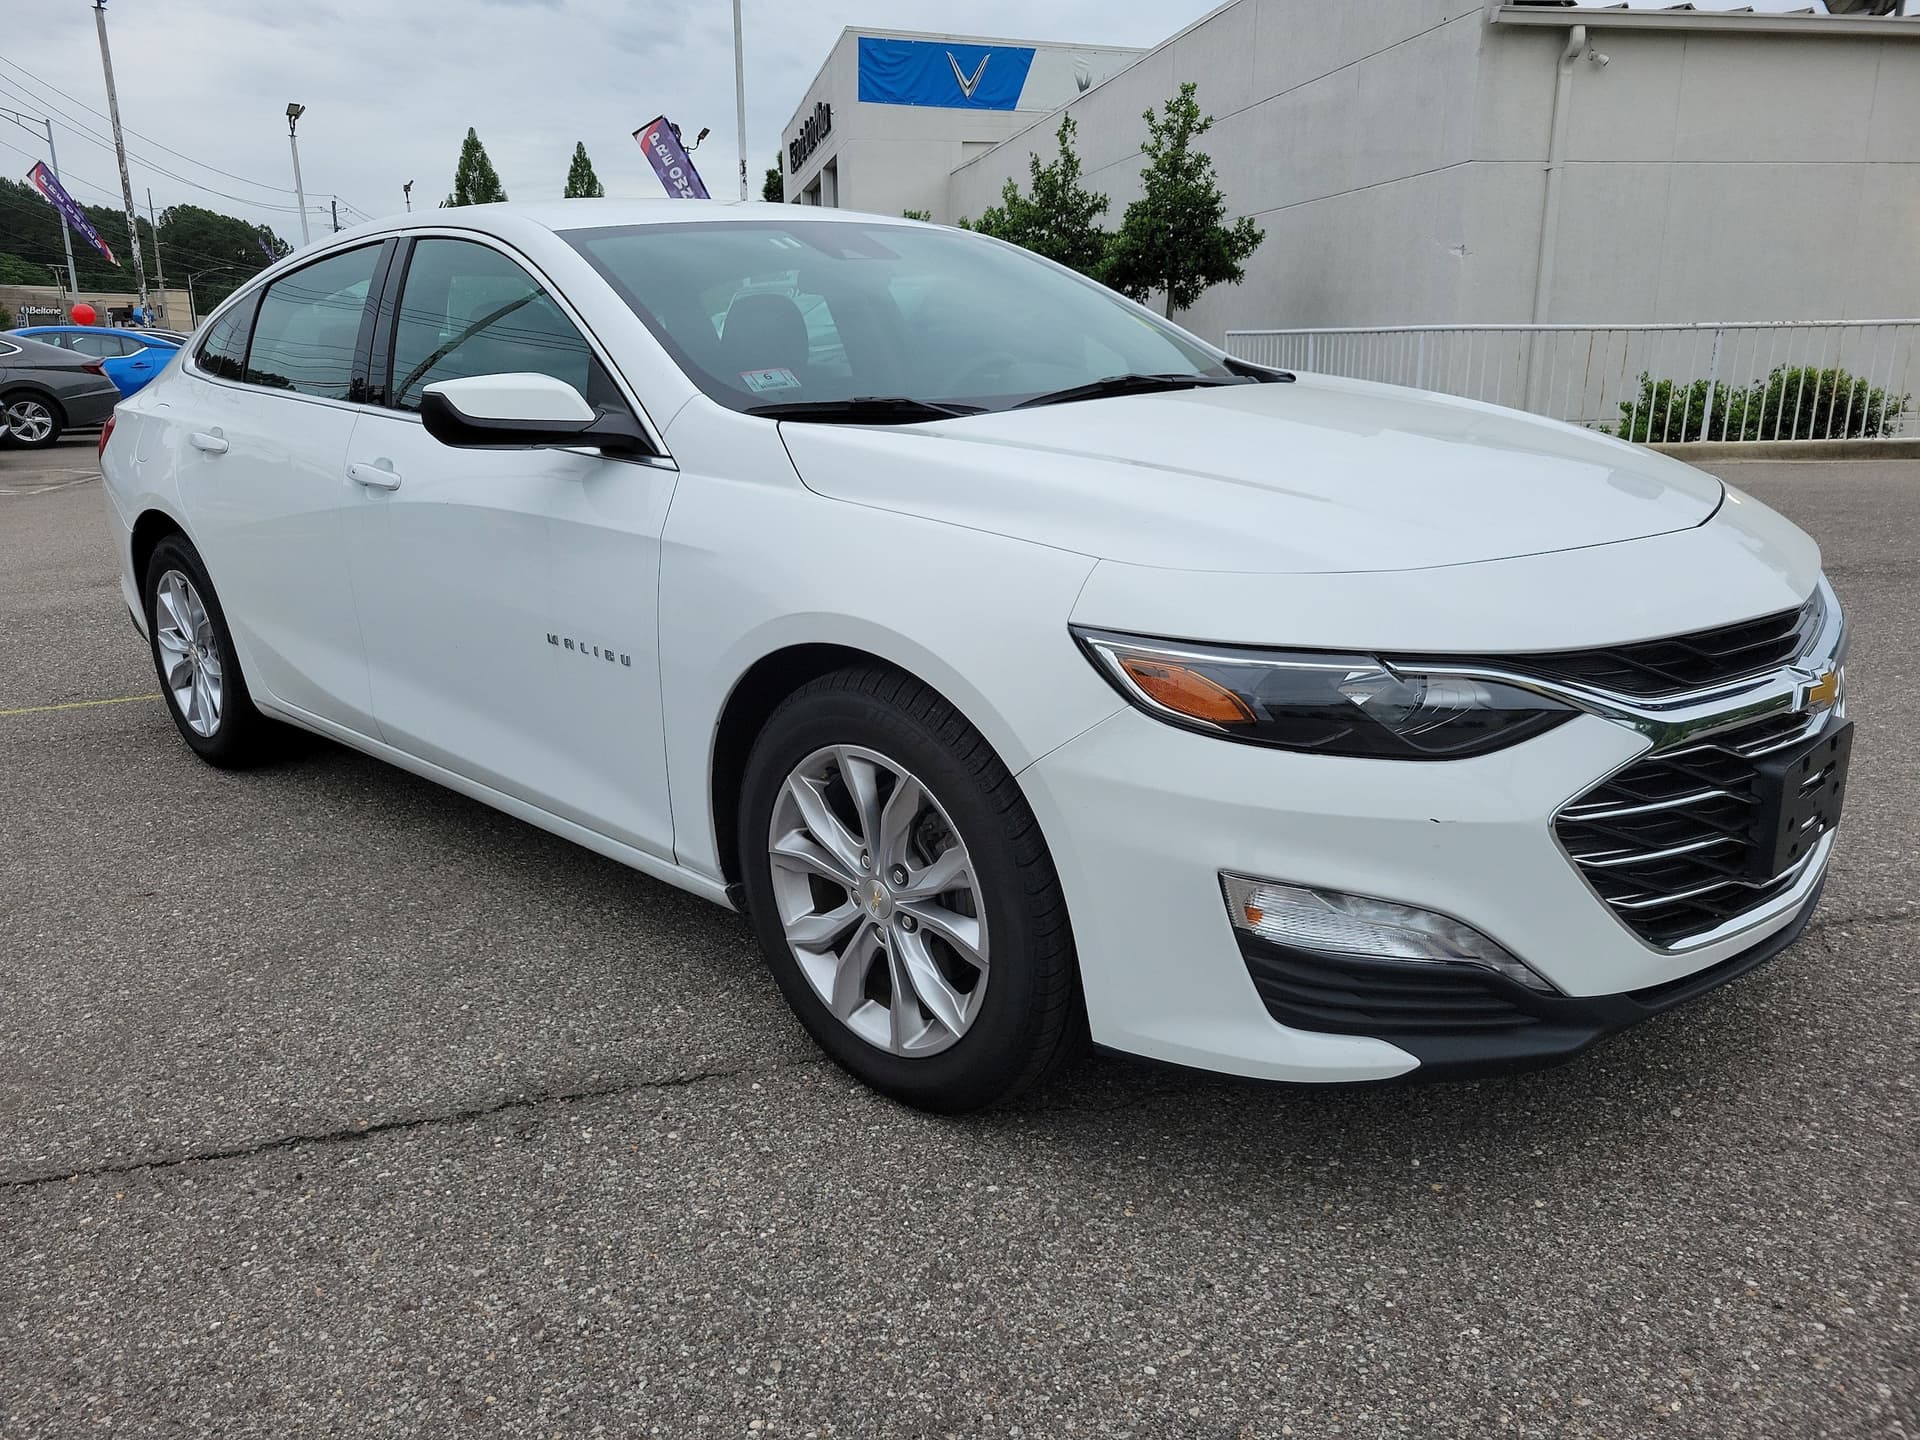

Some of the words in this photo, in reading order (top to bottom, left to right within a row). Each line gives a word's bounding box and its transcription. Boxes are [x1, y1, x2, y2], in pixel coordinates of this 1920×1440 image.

[648, 132, 675, 166] PRE
[669, 167, 695, 199] OWN
[29, 306, 61, 315] Beltone
[546, 632, 631, 667] MALIBU
